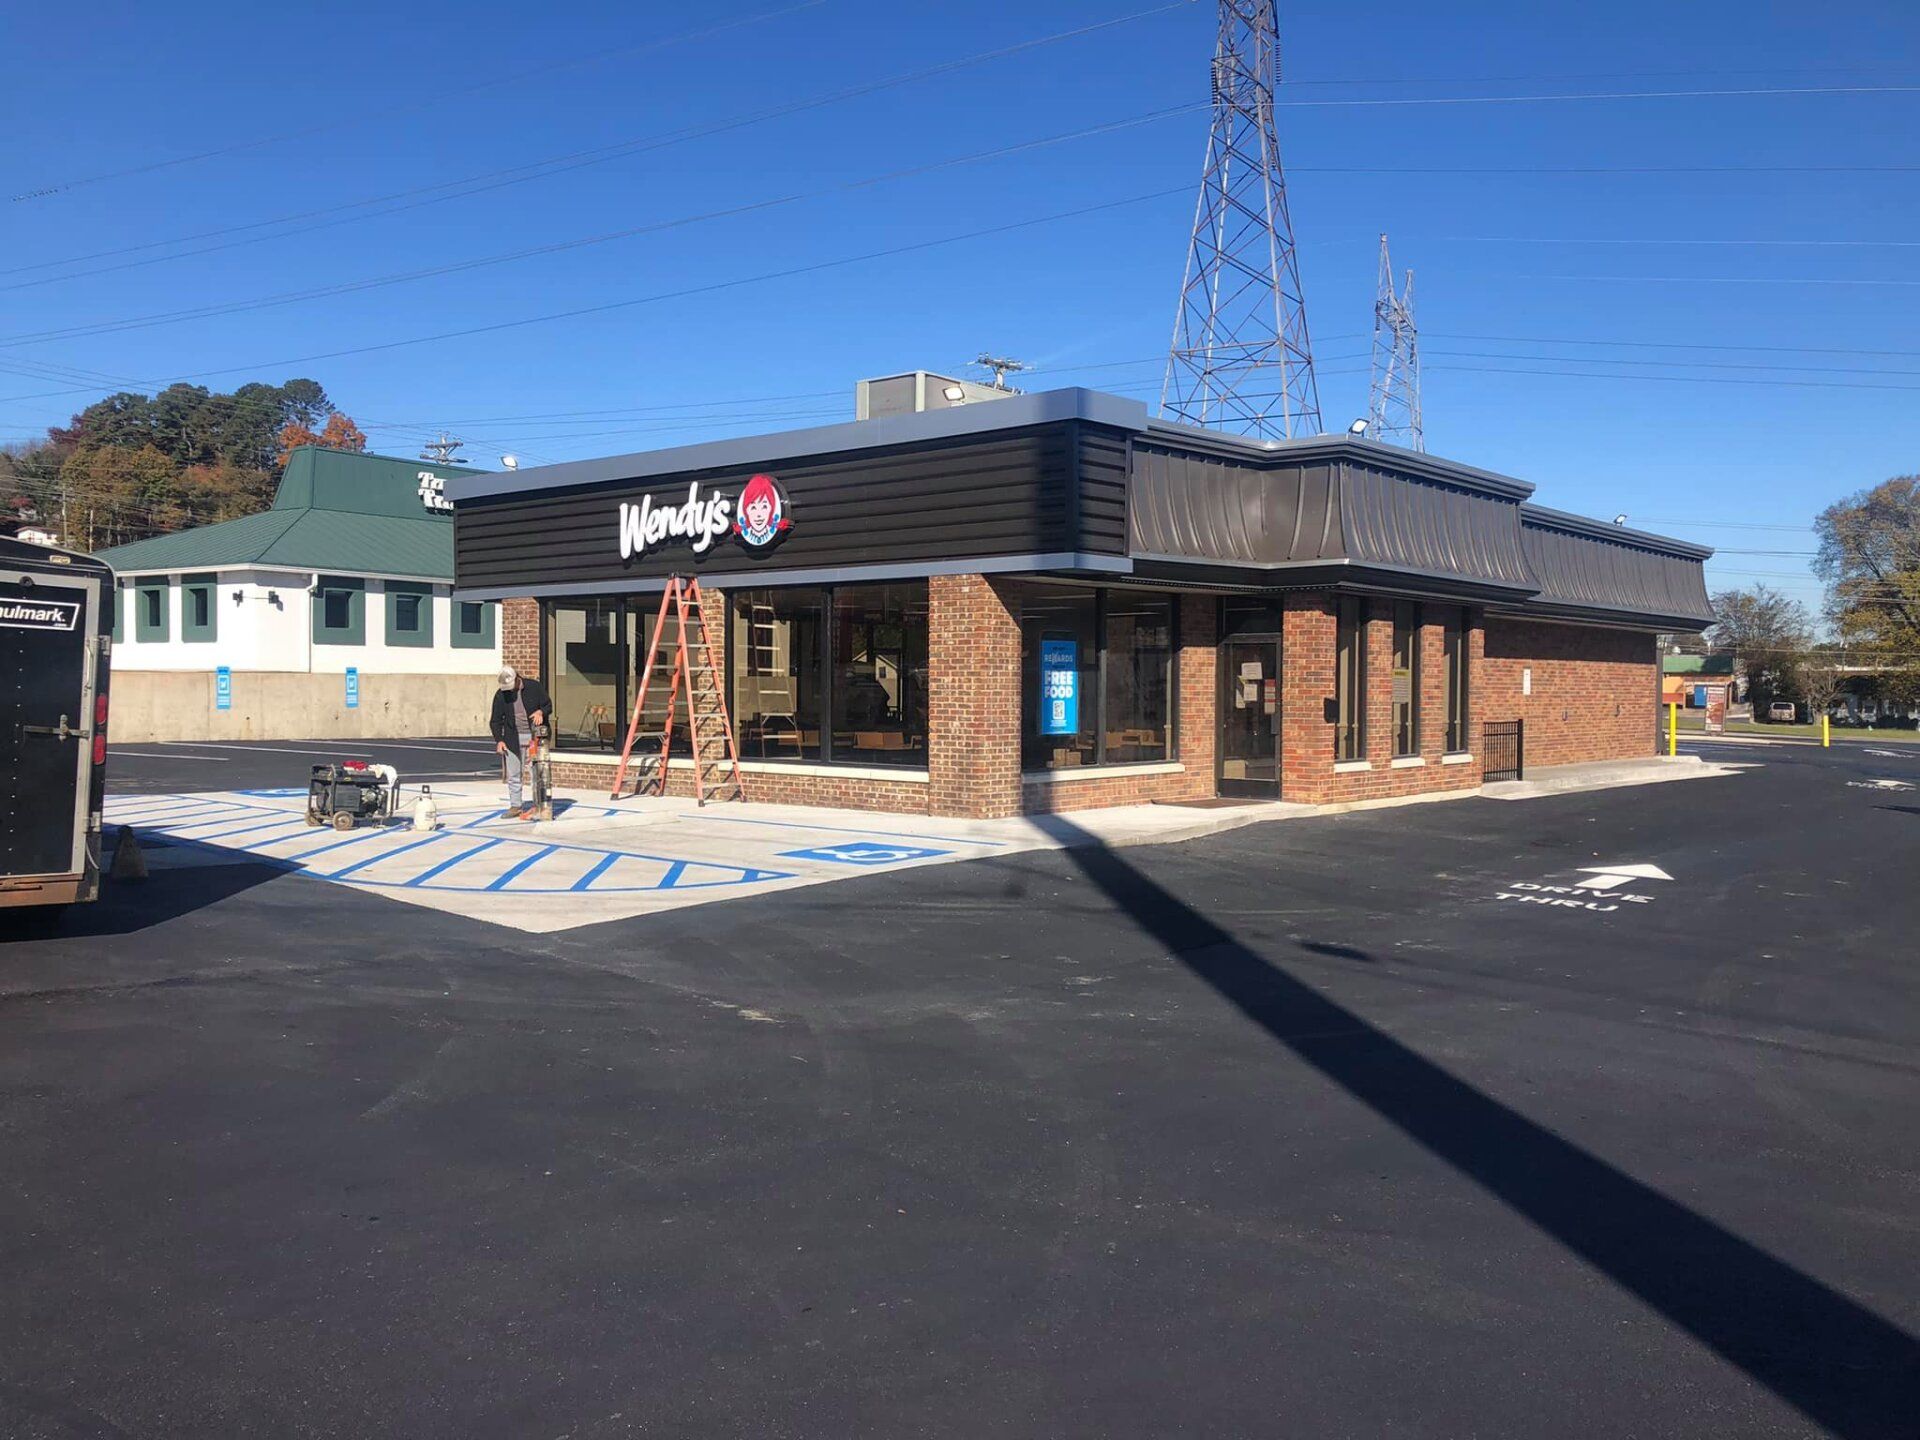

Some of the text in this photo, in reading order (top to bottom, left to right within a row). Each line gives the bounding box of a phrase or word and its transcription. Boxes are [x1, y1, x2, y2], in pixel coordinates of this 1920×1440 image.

[619, 481, 731, 560] Wendy's
[1044, 670, 1073, 685] FREE
[1044, 685, 1074, 698] FOOD
[1495, 892, 1619, 912] THRU
[1509, 882, 1655, 904] DRIVE
